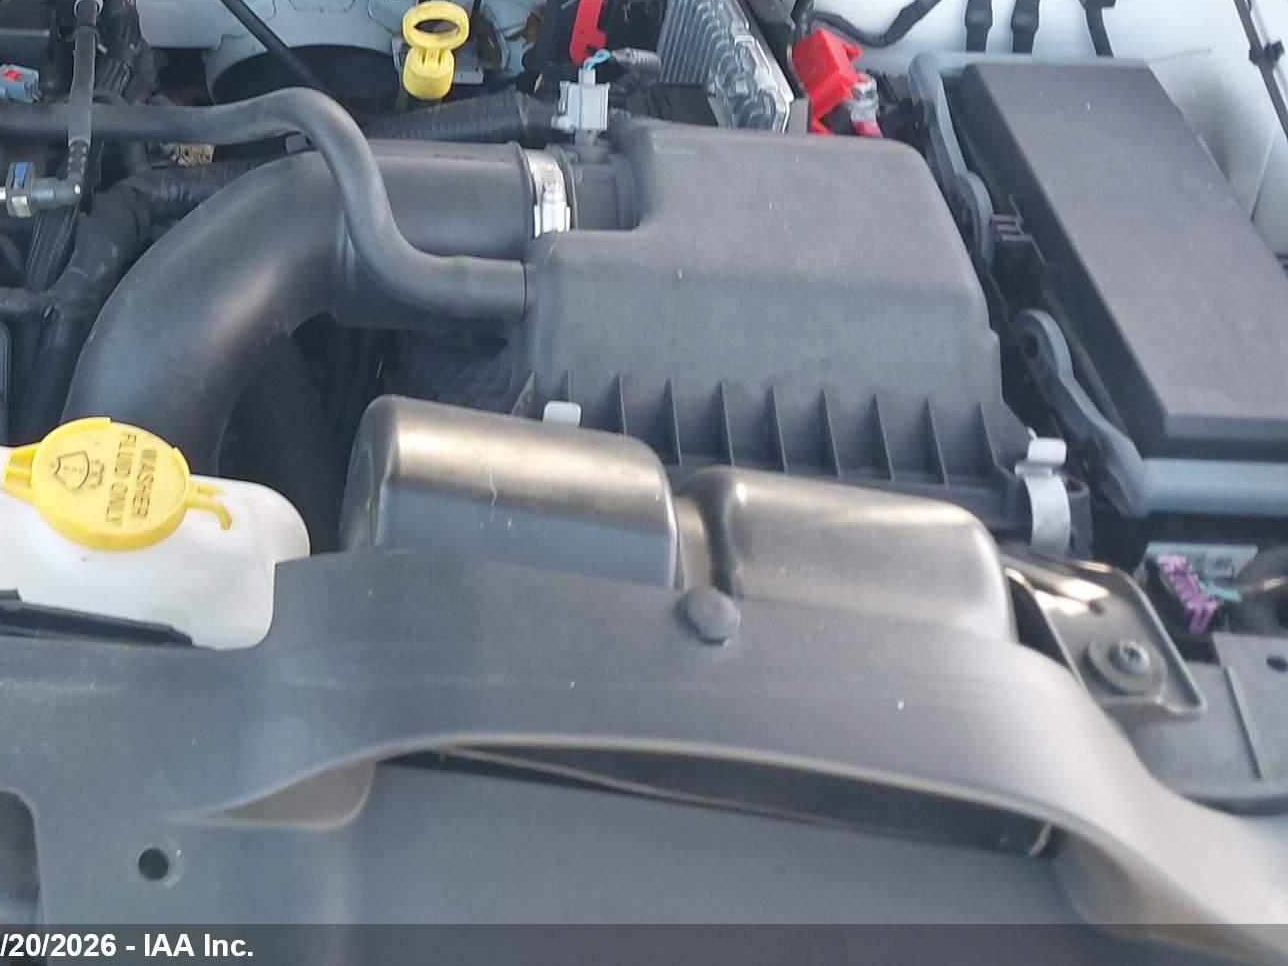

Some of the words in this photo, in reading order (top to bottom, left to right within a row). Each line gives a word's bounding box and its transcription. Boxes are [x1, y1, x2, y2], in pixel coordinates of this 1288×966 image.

[114, 432, 137, 477] FLUID
[105, 481, 129, 527] ONLY
[131, 449, 157, 519] WASHER
